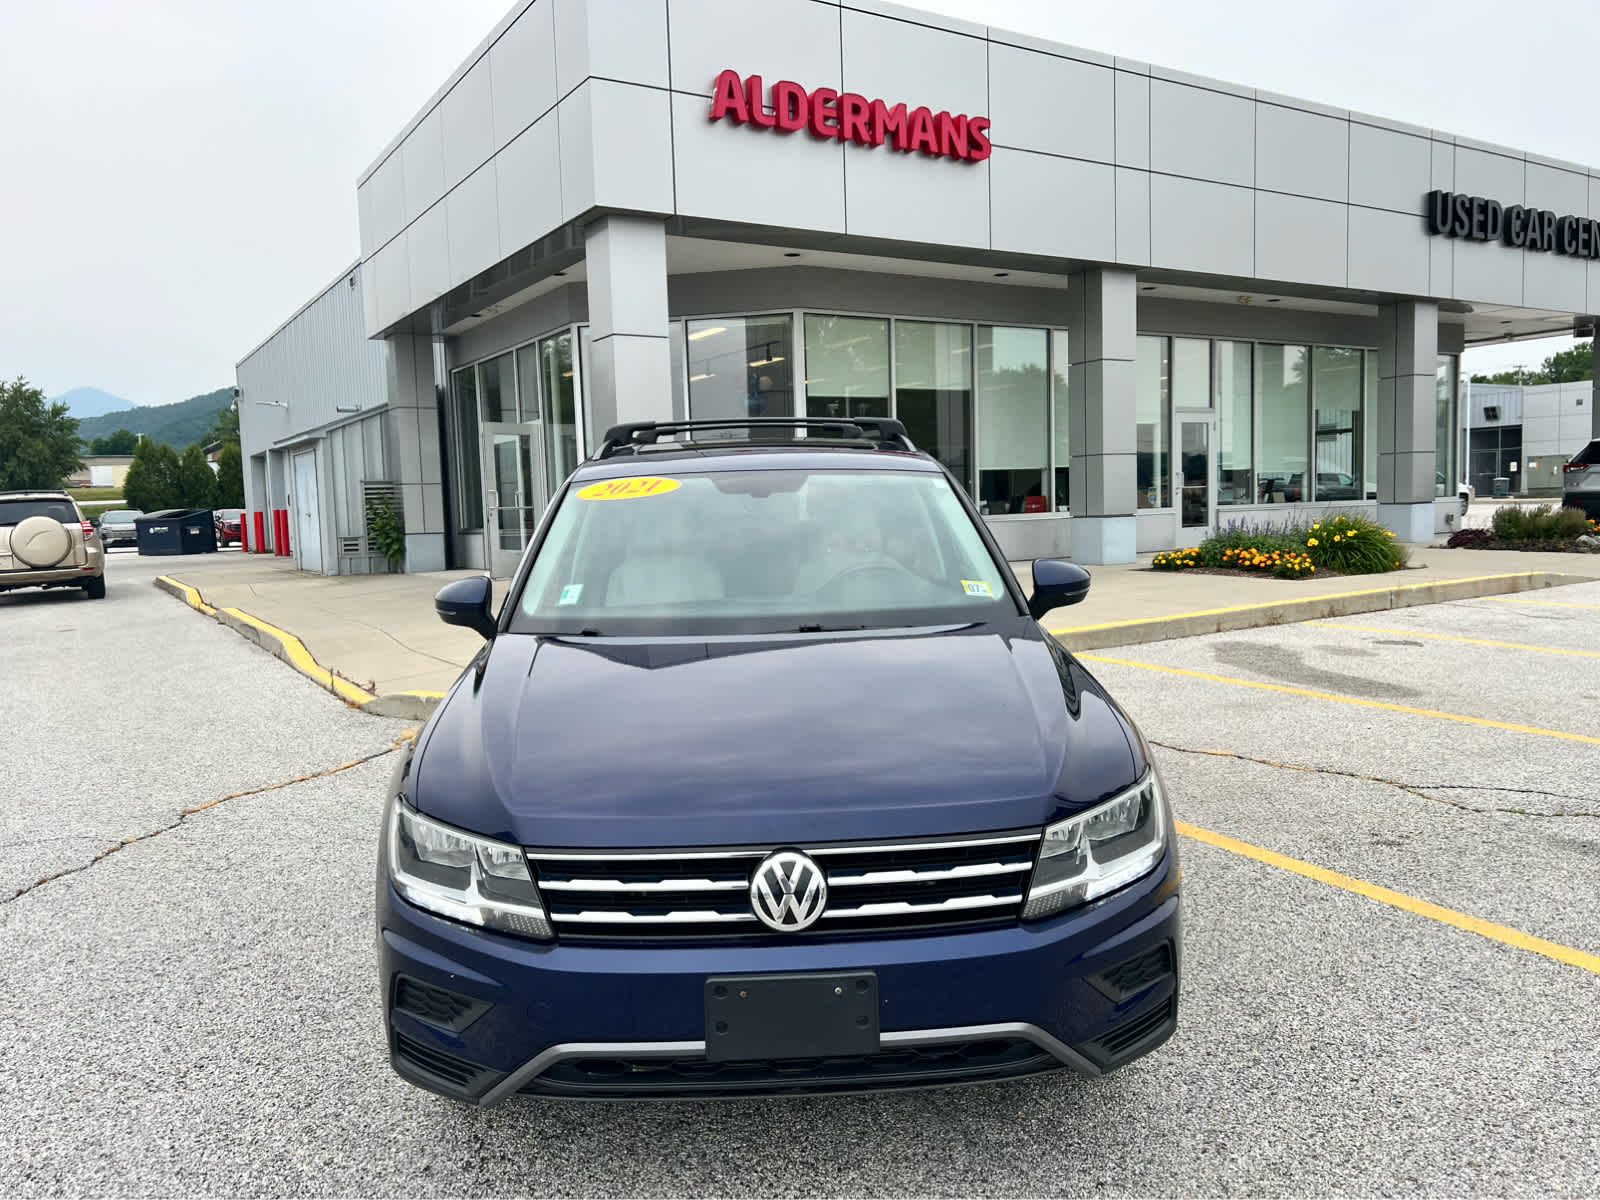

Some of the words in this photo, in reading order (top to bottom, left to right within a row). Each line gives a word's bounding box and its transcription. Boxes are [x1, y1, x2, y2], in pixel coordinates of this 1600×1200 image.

[709, 69, 992, 162] ALDERMANS
[1430, 190, 1503, 241] USED
[1504, 204, 1556, 251] CAR
[593, 480, 663, 497] 2021
[751, 852, 827, 931] VW
